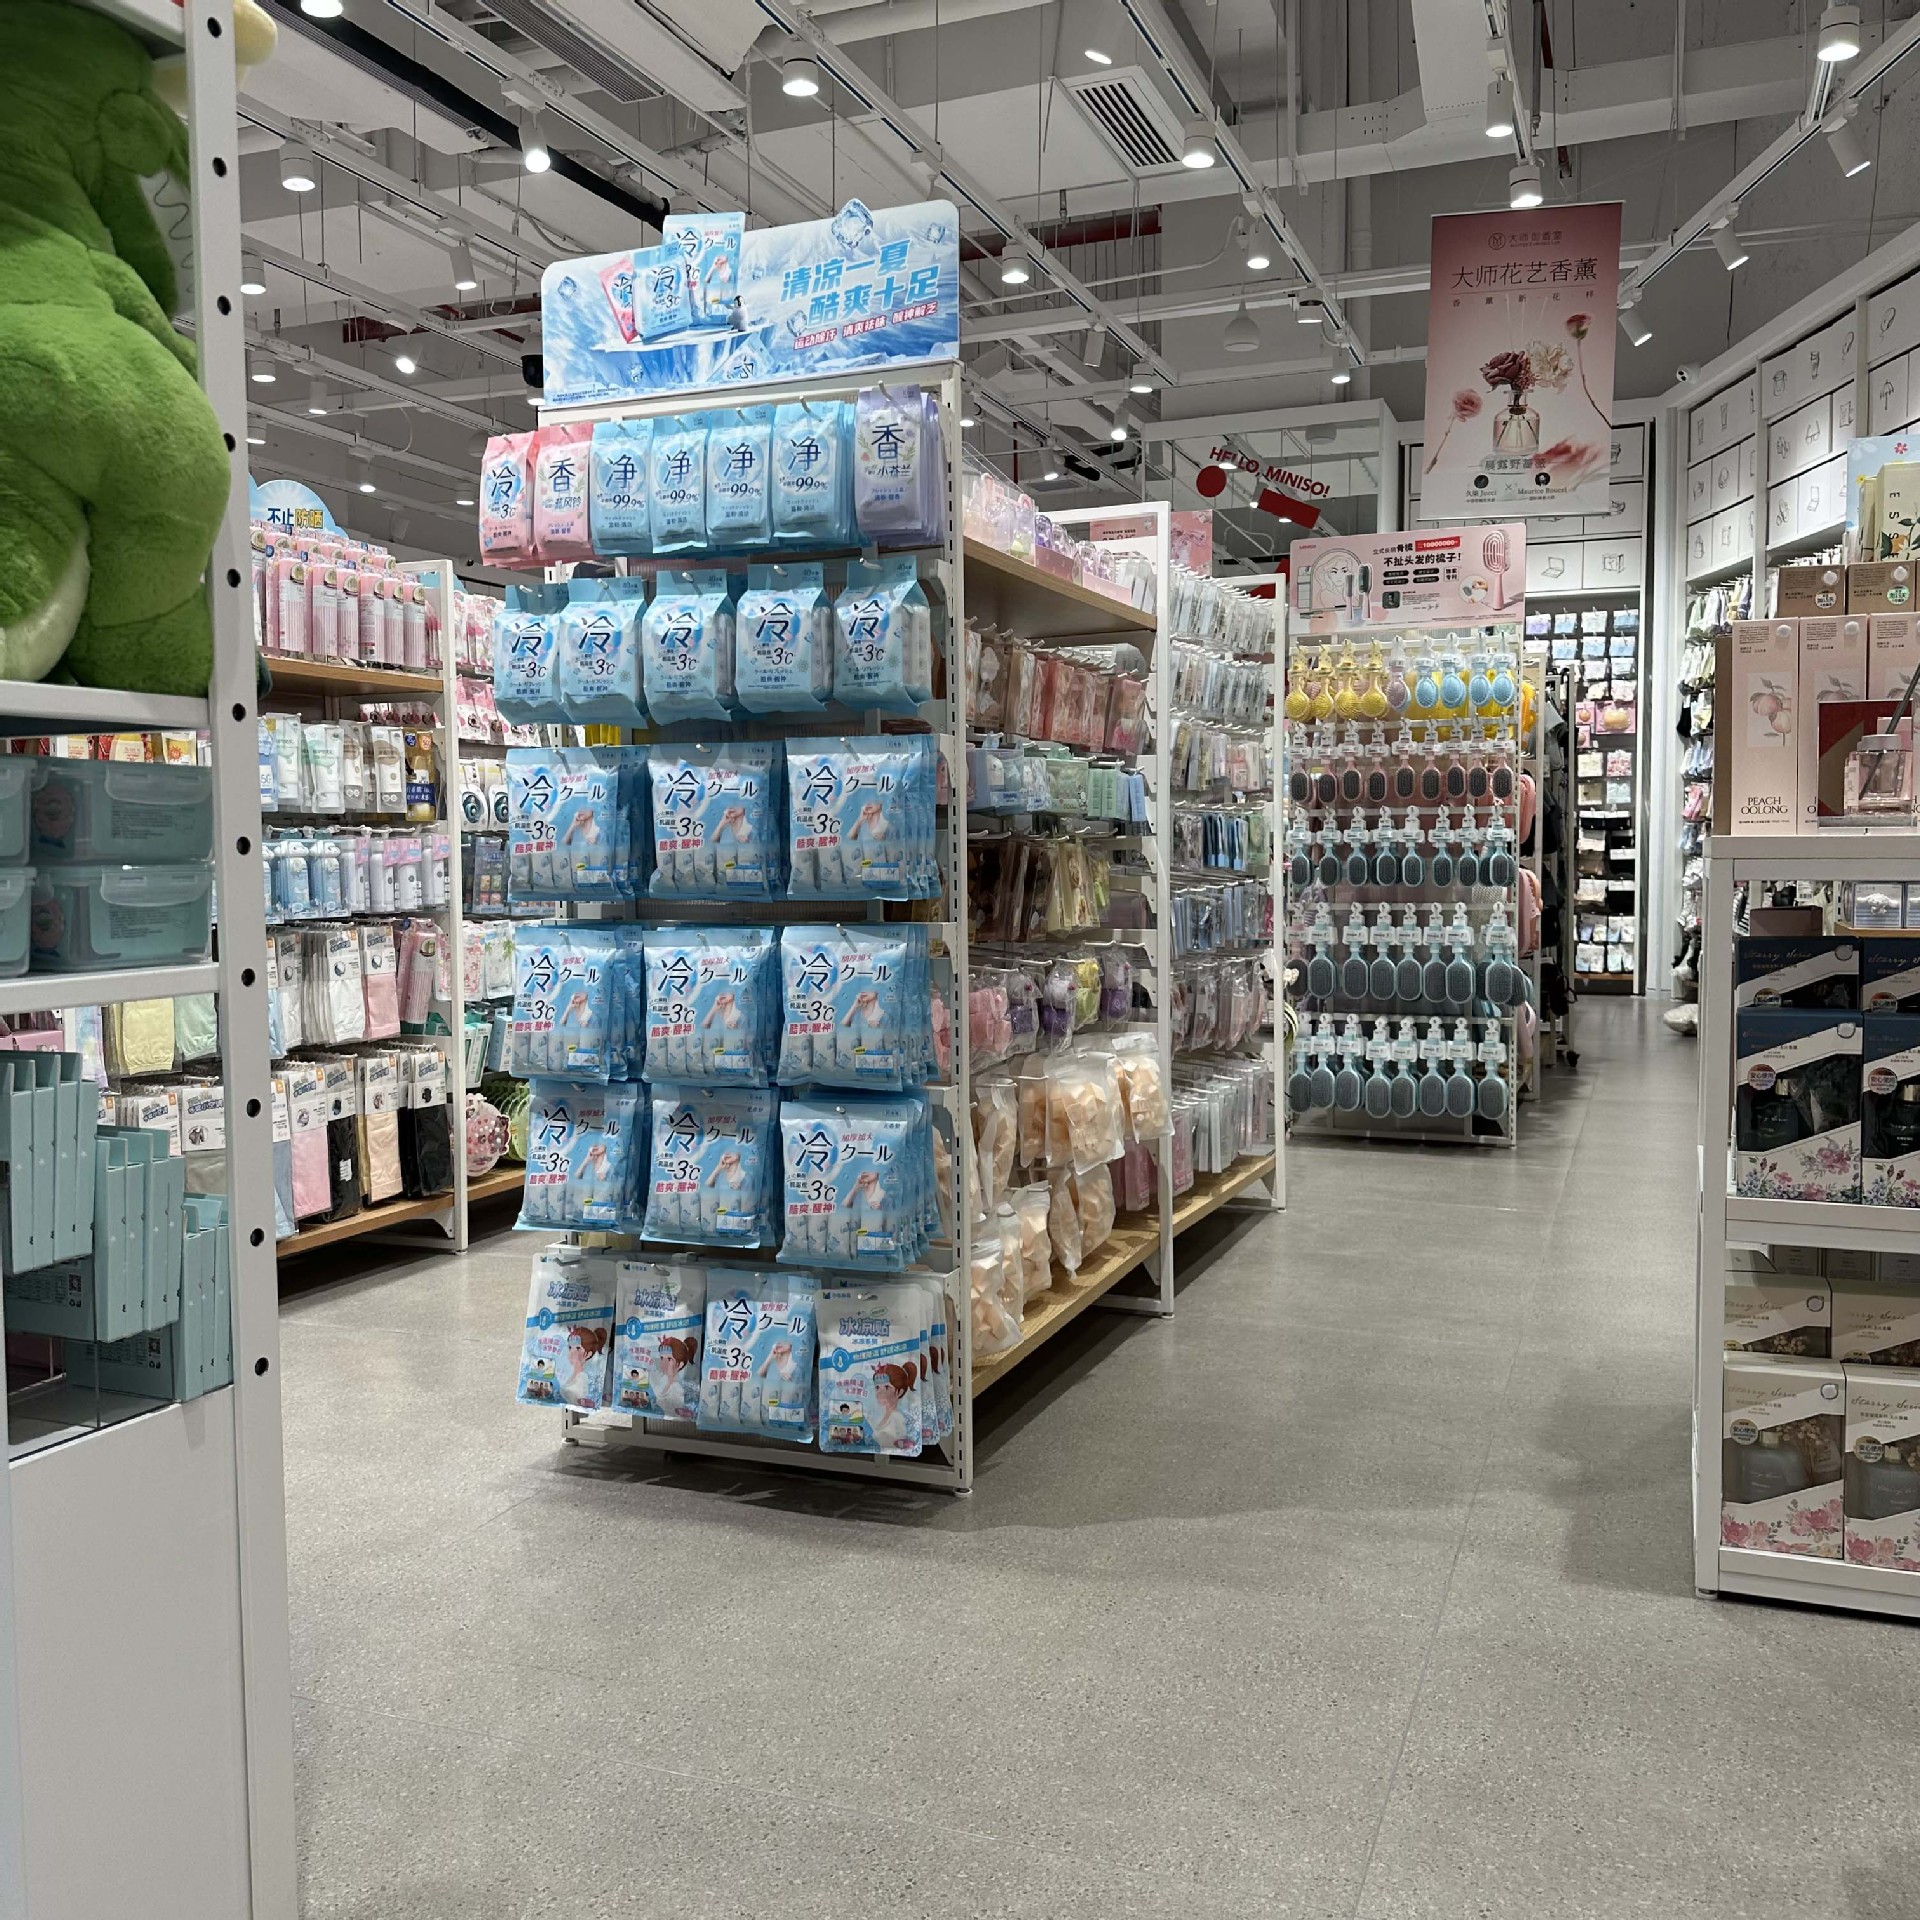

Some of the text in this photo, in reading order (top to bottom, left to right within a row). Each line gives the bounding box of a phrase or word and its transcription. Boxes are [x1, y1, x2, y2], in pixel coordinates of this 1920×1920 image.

[651, 265, 677, 293] 冷
[781, 239, 911, 302] 清凉一夏
[1451, 257, 1599, 290] 大师花艺香薰
[808, 264, 941, 328] 酷爽十足
[788, 436, 822, 471] 净
[871, 423, 906, 460] 香
[548, 458, 576, 493] 香
[606, 454, 638, 489] 净
[663, 449, 692, 485] 净
[723, 442, 756, 478] 净
[491, 465, 516, 499] 冷
[1266, 465, 1331, 498] MINISO!
[267, 507, 324, 529] 不止防晒
[1384, 553, 1462, 567] 不扯头发的梳子!
[578, 615, 615, 653] 冷
[660, 612, 698, 648] 冷
[756, 602, 794, 643] 冷
[848, 600, 884, 638] 冷
[511, 622, 546, 656] 冷
[520, 775, 554, 813] 冷
[560, 785, 606, 801] クール
[664, 770, 701, 809] 冷
[707, 781, 758, 797] クール
[801, 765, 838, 805] 冷
[845, 775, 895, 794] クール
[1747, 797, 1782, 806] PEACH
[1740, 805, 1788, 815] OOLONG
[523, 955, 556, 993] 冷
[560, 967, 600, 984] クール
[658, 957, 694, 996] 冷
[700, 967, 748, 984] クール
[796, 952, 833, 993] 冷
[841, 965, 892, 982] クール
[538, 1106, 571, 1145] 冷
[576, 1119, 620, 1136] クール
[664, 1112, 700, 1152] 冷
[706, 1125, 755, 1144] クール
[795, 1131, 833, 1172] 冷
[841, 1144, 893, 1163] クール
[718, 1299, 753, 1340] 冷
[758, 1313, 806, 1334] クール
[839, 1317, 891, 1338] 冰凉贴
